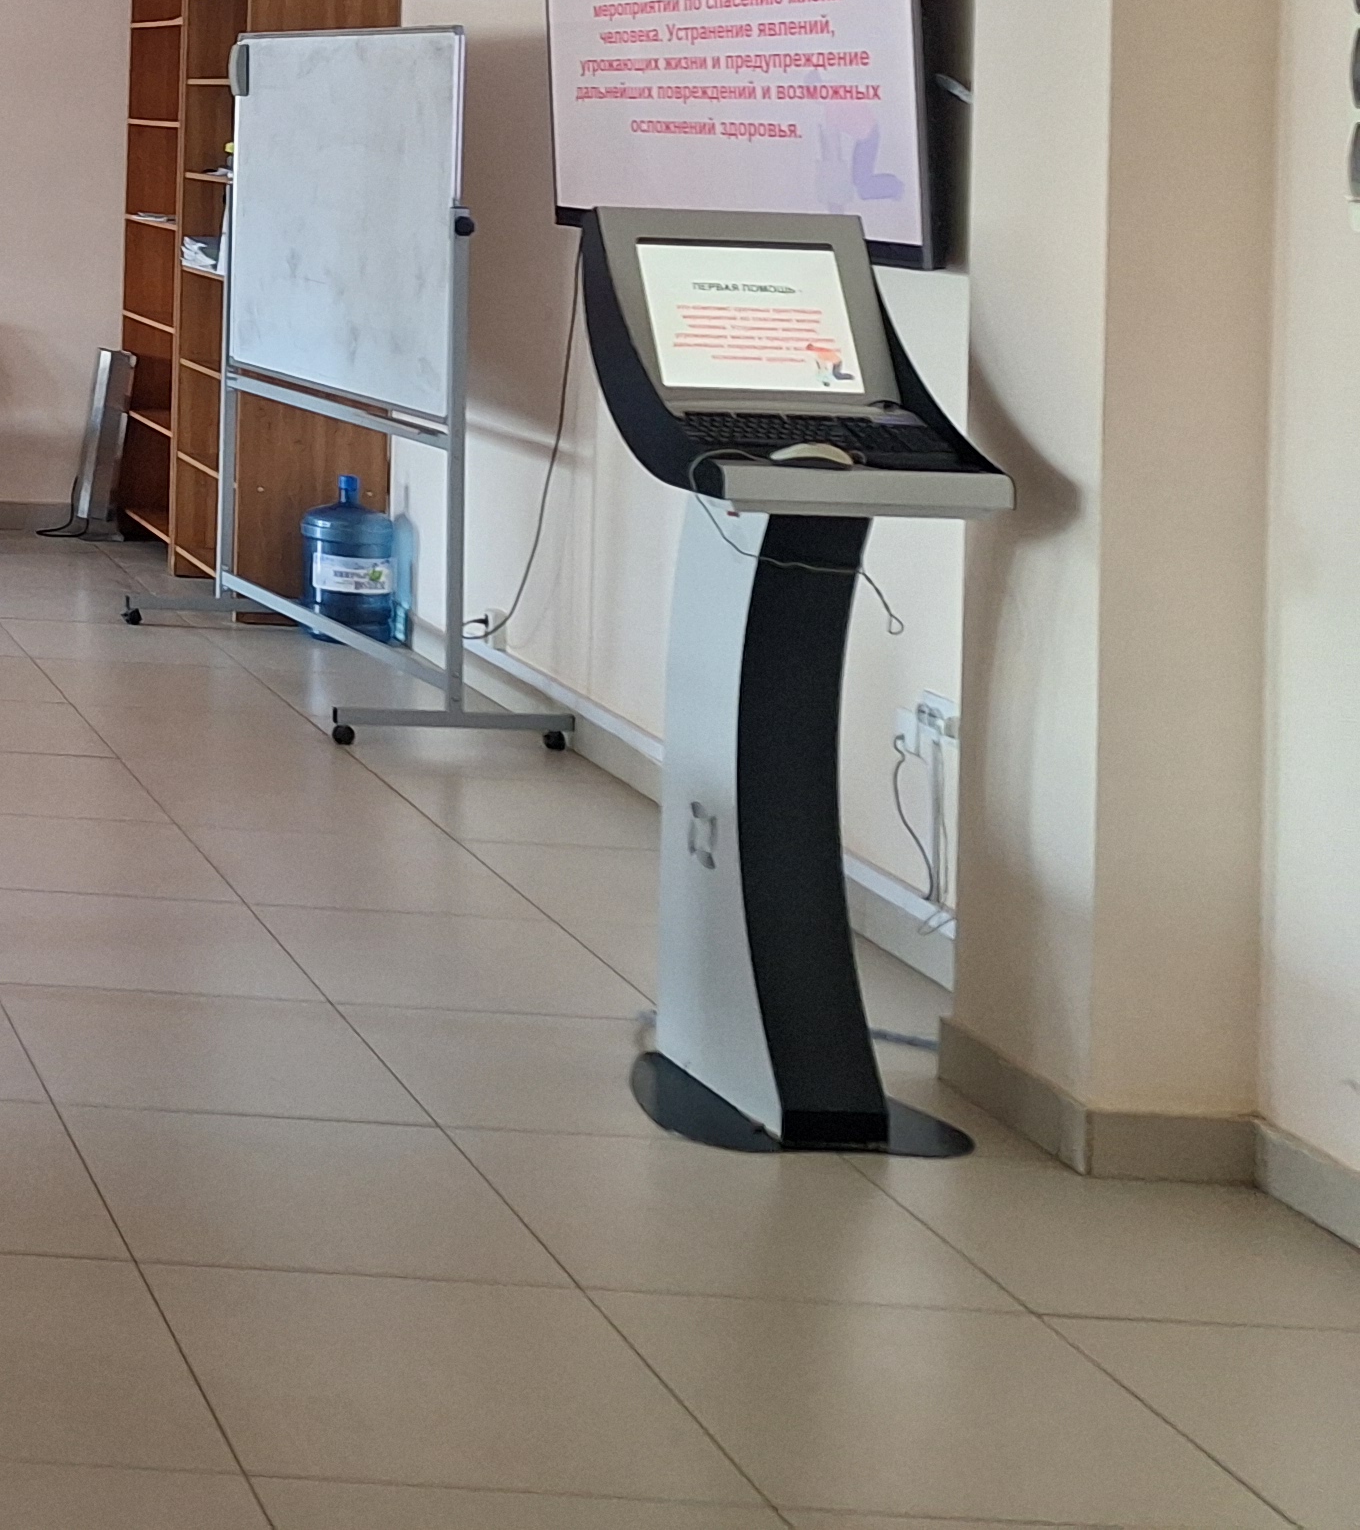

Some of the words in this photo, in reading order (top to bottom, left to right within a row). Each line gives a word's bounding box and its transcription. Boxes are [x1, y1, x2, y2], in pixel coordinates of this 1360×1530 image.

[600, 28, 663, 45] человека.
[666, 19, 753, 46] Устранение
[757, 13, 836, 38] явлений,
[579, 57, 660, 77] угрожающих
[663, 56, 708, 70] жизни
[712, 56, 721, 70] и
[725, 50, 871, 74] предупреждение
[576, 81, 655, 102] дальнейших
[657, 80, 757, 104] повреждений
[761, 85, 772, 100] и
[776, 84, 882, 101] возможных
[630, 116, 717, 136] осложнений
[720, 121, 803, 143] здоровья.
[691, 281, 740, 293] ПЕРВАЯ
[741, 283, 796, 294] ПОМОЩЬ
